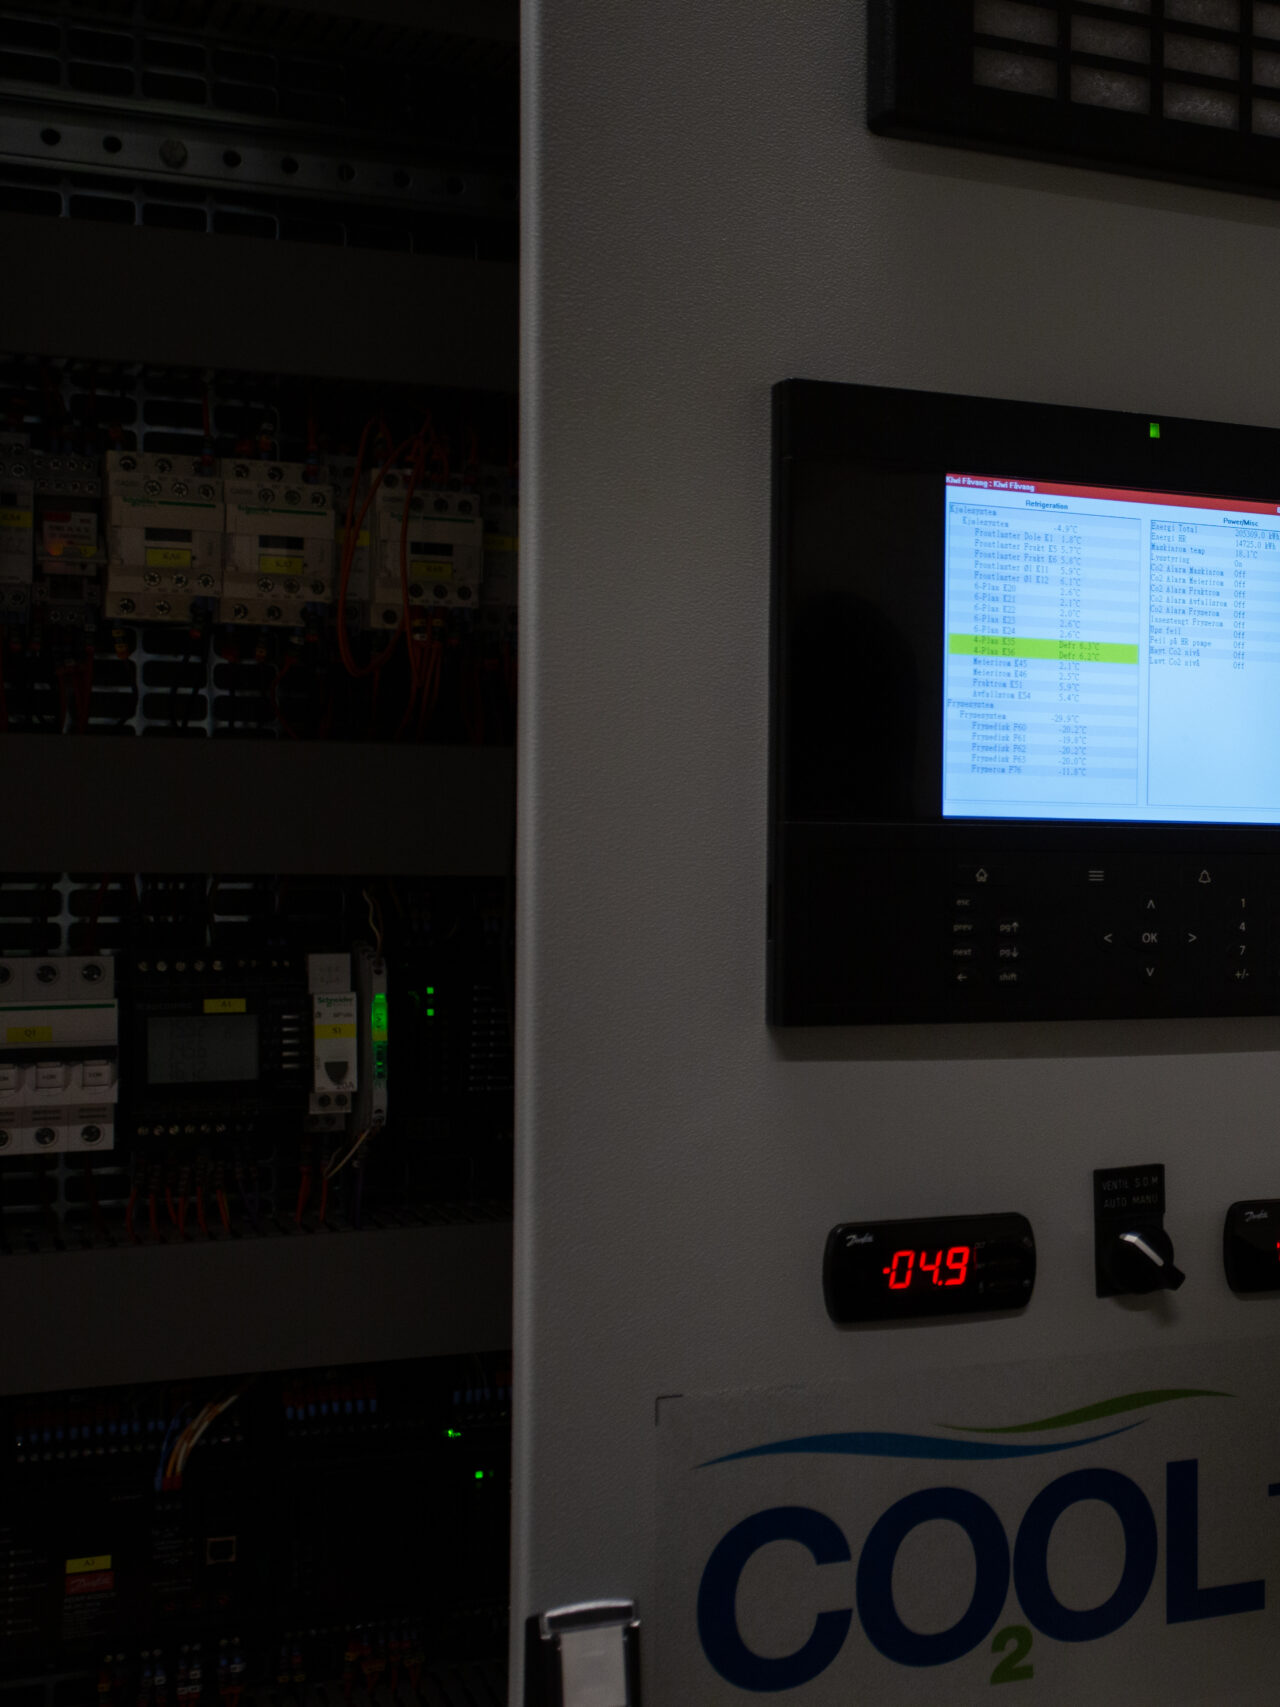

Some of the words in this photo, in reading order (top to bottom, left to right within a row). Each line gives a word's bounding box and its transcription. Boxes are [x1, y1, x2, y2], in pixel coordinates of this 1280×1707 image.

[1025, 500, 1069, 510] Refrigeration
[1223, 517, 1259, 527] Power/Misc
[1241, 898, 1246, 908] 1
[1239, 922, 1246, 932] 4
[1142, 932, 1158, 944] OK
[1239, 945, 1246, 955] 7
[881, 1245, 971, 1290] -04.9
